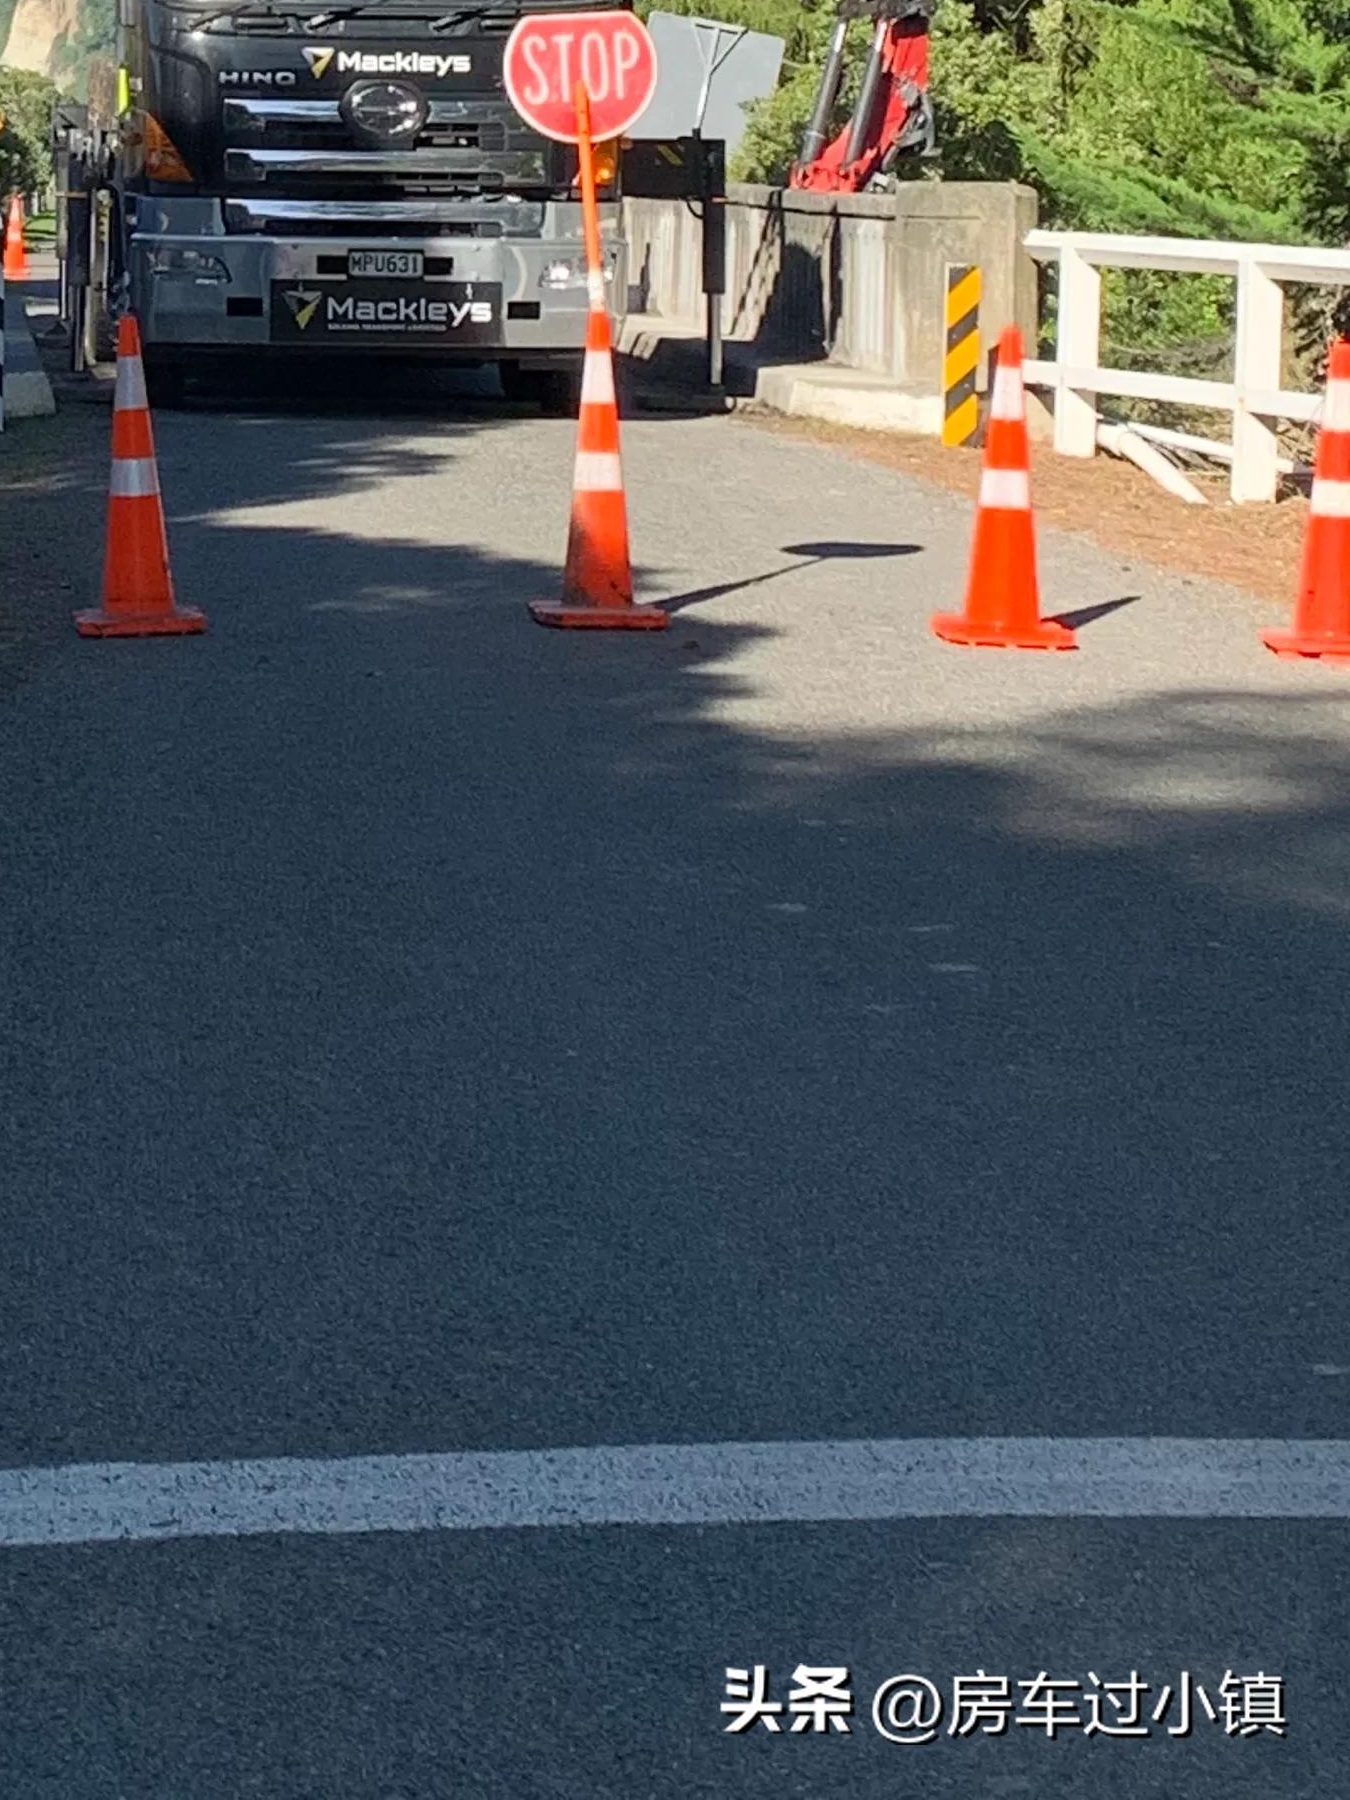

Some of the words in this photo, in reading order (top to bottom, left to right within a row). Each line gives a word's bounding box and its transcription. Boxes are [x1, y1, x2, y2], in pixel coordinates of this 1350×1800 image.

[338, 52, 471, 77] Mackleys
[522, 31, 640, 105] STOP
[219, 71, 296, 85] HINO
[351, 255, 419, 273] MPU631
[326, 297, 492, 327] Mackleys
